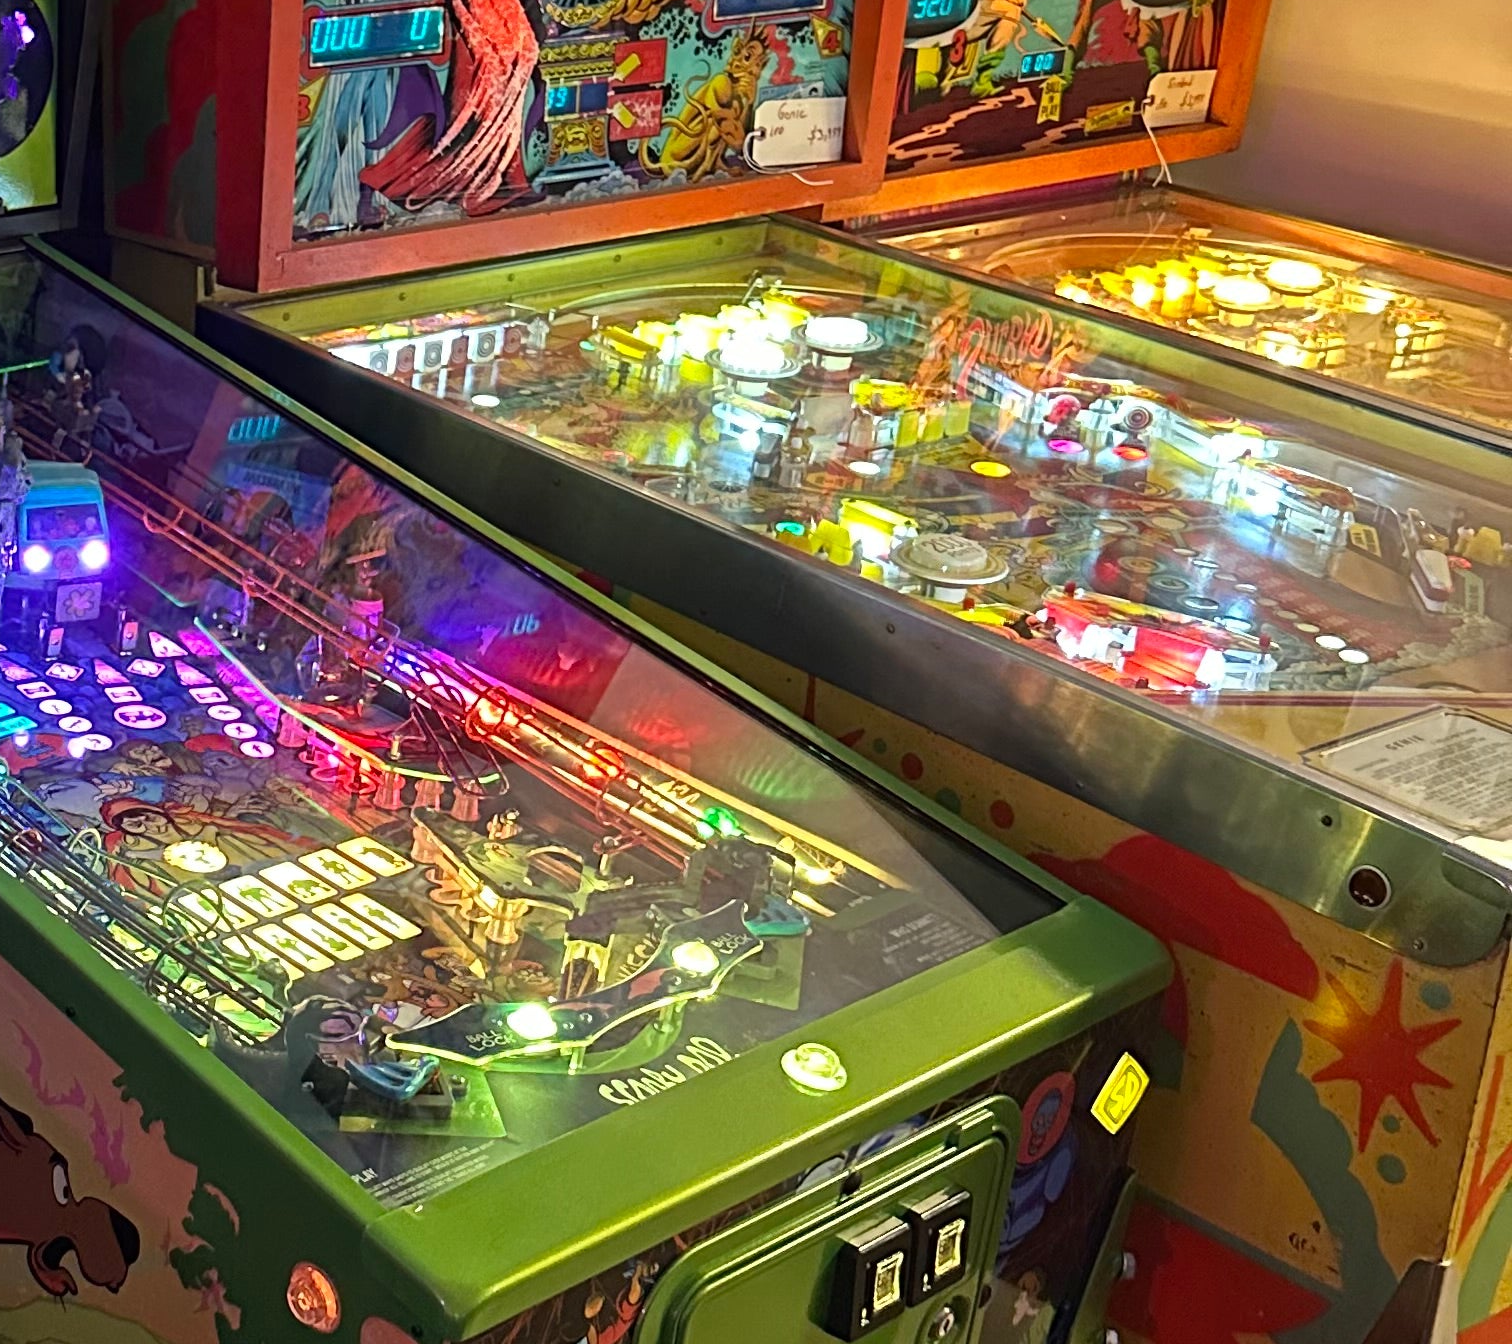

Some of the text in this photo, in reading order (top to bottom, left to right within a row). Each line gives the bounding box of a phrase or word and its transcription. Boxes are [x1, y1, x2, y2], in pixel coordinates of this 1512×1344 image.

[952, 28, 967, 57] 3
[1385, 734, 1425, 752] GENIE
[709, 933, 740, 949] BALL
[717, 934, 754, 955] LOCK
[465, 1029, 499, 1045] BALL
[468, 1032, 517, 1053] LOCK
